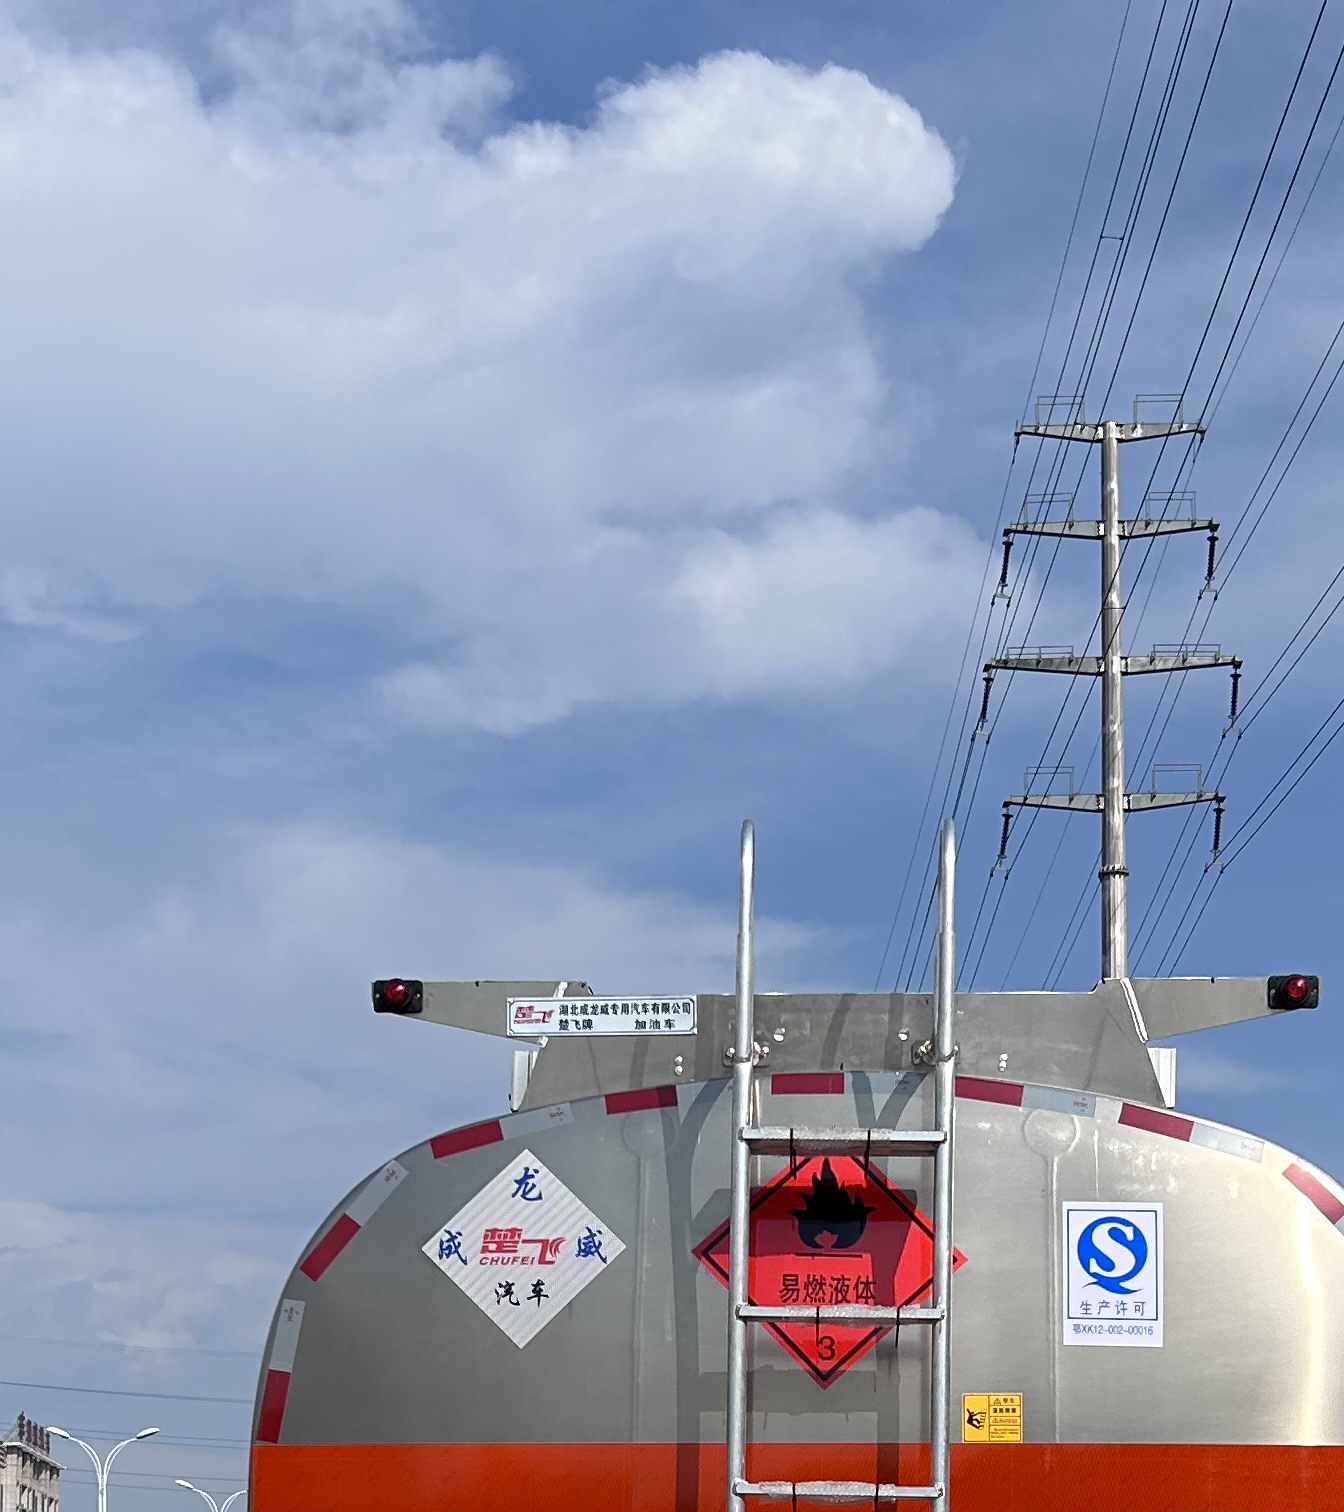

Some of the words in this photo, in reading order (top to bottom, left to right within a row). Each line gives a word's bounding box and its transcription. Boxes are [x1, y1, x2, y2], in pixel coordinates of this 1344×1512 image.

[559, 1002, 691, 1016] 湖北成龙威专用汽车有限公司
[559, 1018, 594, 1031] 楚飞牌
[635, 1018, 676, 1031] 加油车
[511, 1166, 544, 1202] 龙
[438, 1228, 468, 1266] 成
[575, 1226, 608, 1265] 威
[479, 1255, 536, 1266] CHUFEI
[494, 1279, 550, 1308] 汽车
[779, 1273, 877, 1305] 易燃液体
[1079, 1300, 1147, 1317] 生产许可
[817, 1335, 837, 1361] 3
